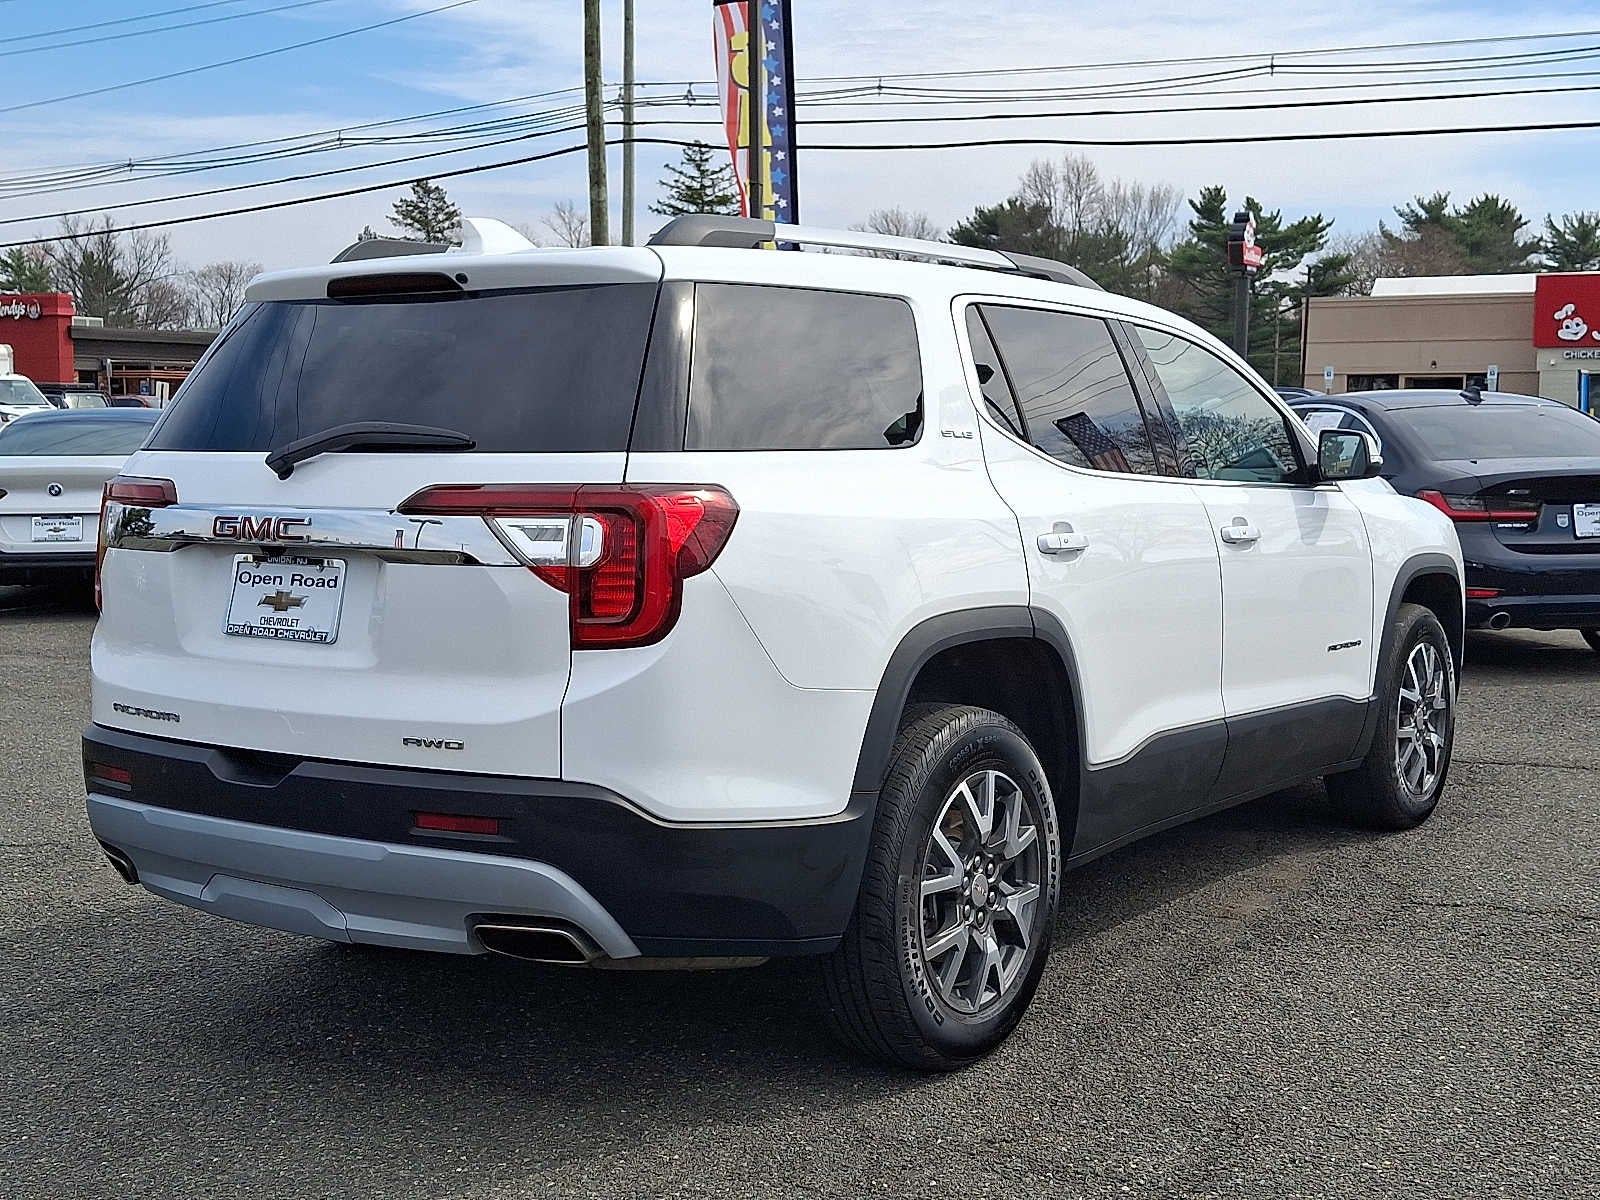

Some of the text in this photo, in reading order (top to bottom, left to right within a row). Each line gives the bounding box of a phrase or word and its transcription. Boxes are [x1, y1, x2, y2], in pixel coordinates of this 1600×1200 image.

[0, 298, 26, 320] endy's
[212, 515, 312, 543] GMC
[296, 557, 308, 566] NJ
[238, 570, 339, 589] Open Road
[259, 616, 300, 629] CHEVROLET
[227, 624, 329, 642] OPEN ROAD CHEVROLET
[1327, 639, 1362, 653] ACADIA
[112, 702, 181, 723] ACADIA
[402, 736, 465, 751] AWD
